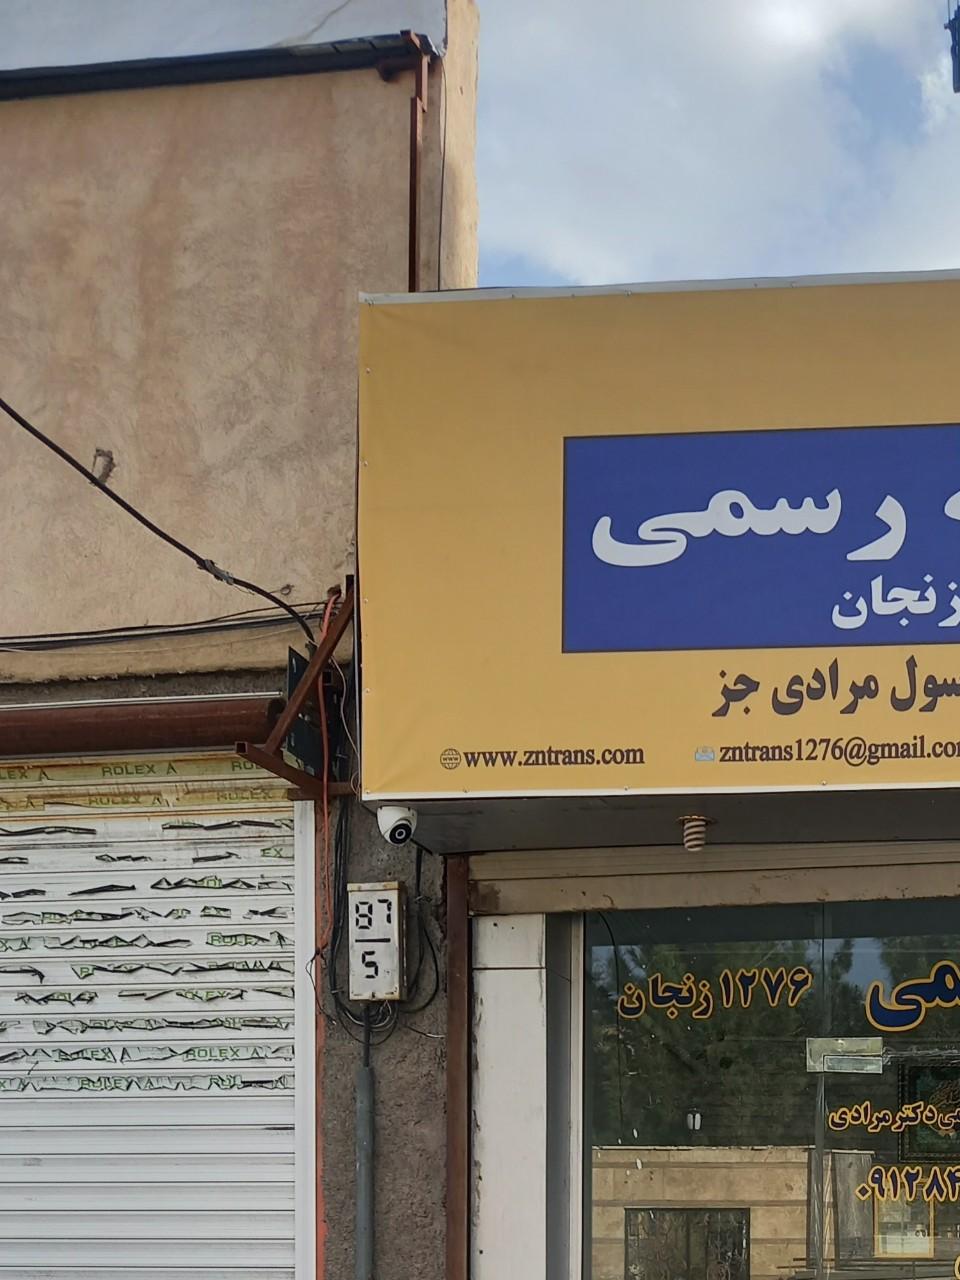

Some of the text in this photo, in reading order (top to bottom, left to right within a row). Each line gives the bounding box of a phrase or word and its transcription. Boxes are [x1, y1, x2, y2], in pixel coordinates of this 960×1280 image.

[591, 487, 908, 568] رسمی
[711, 669, 761, 718] جز
[771, 657, 880, 716] مرادی
[101, 763, 156, 777] ROLEX
[463, 746, 646, 768] www.zntrans.com
[617, 972, 714, 1020] زنجان
[719, 965, 813, 1009] ۱۲۷۶
[828, 1100, 893, 1132] مرادی
